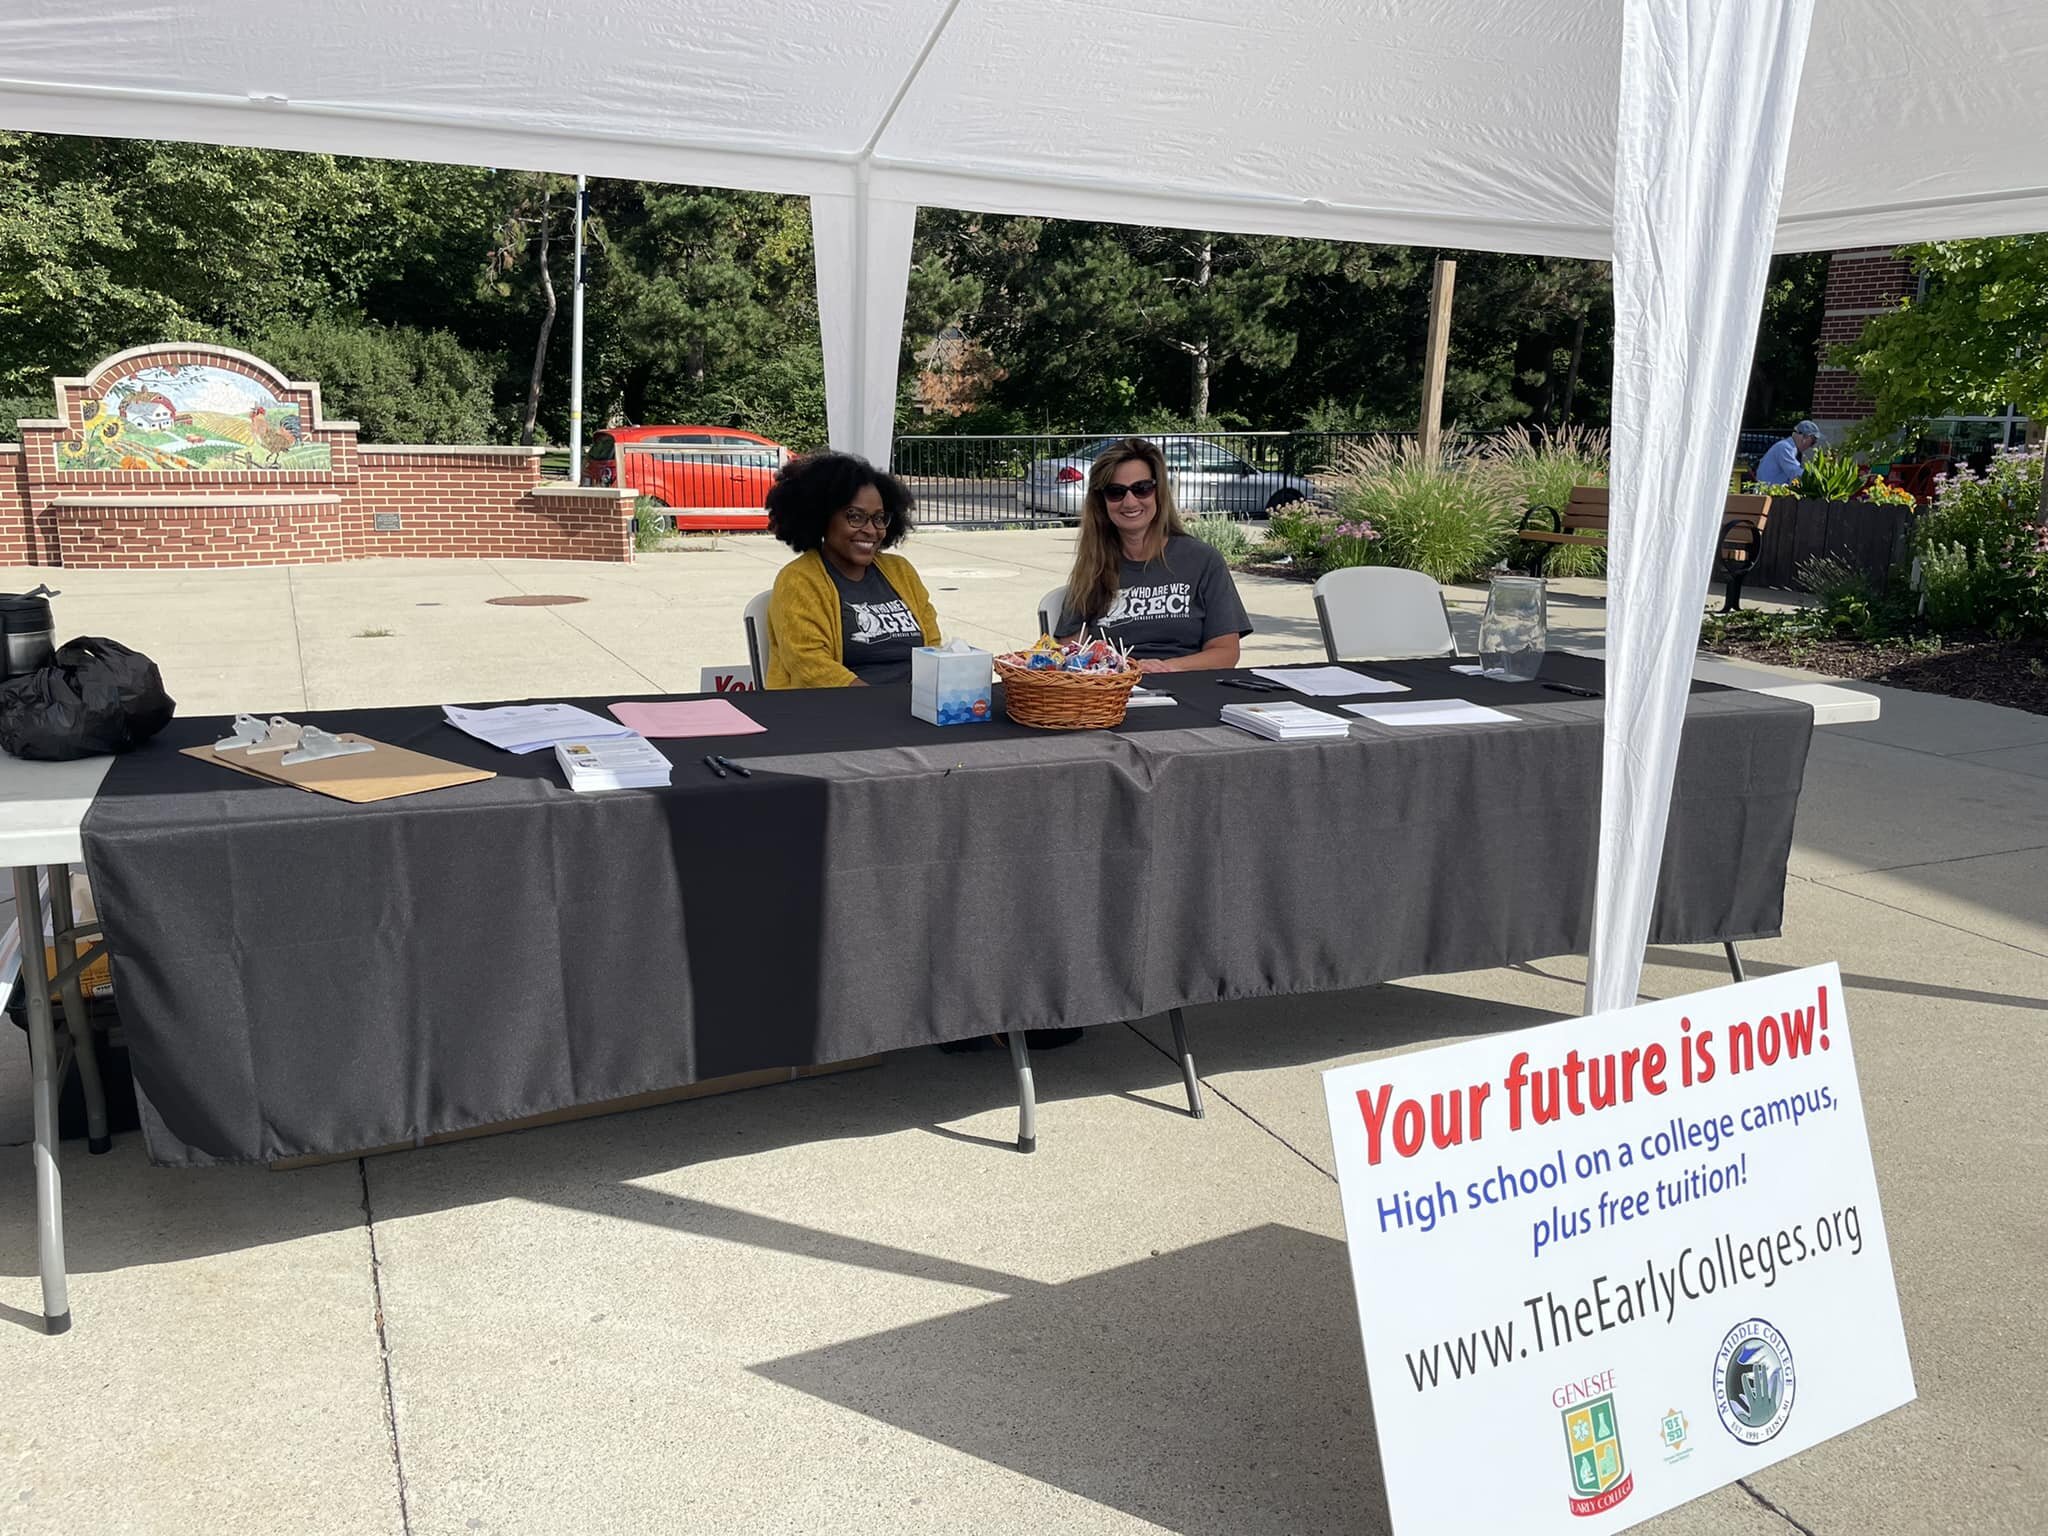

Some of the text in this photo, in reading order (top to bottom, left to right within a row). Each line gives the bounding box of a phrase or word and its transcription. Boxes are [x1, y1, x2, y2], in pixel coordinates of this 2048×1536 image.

[1129, 594, 1190, 617] GEC!
[1131, 583, 1190, 598] WHO ARE WE?
[1356, 985, 1830, 1165] Your future is now!
[1377, 1086, 1838, 1232] High school on a college campus,
[1533, 1153, 1747, 1257] plus free tuition!
[1405, 1204, 1863, 1393] www.TheEarlyColleges.org
[1552, 1368, 1617, 1408] GENESEE
[1716, 1323, 1793, 1414] MOTT MIDDLE COLLEGE
